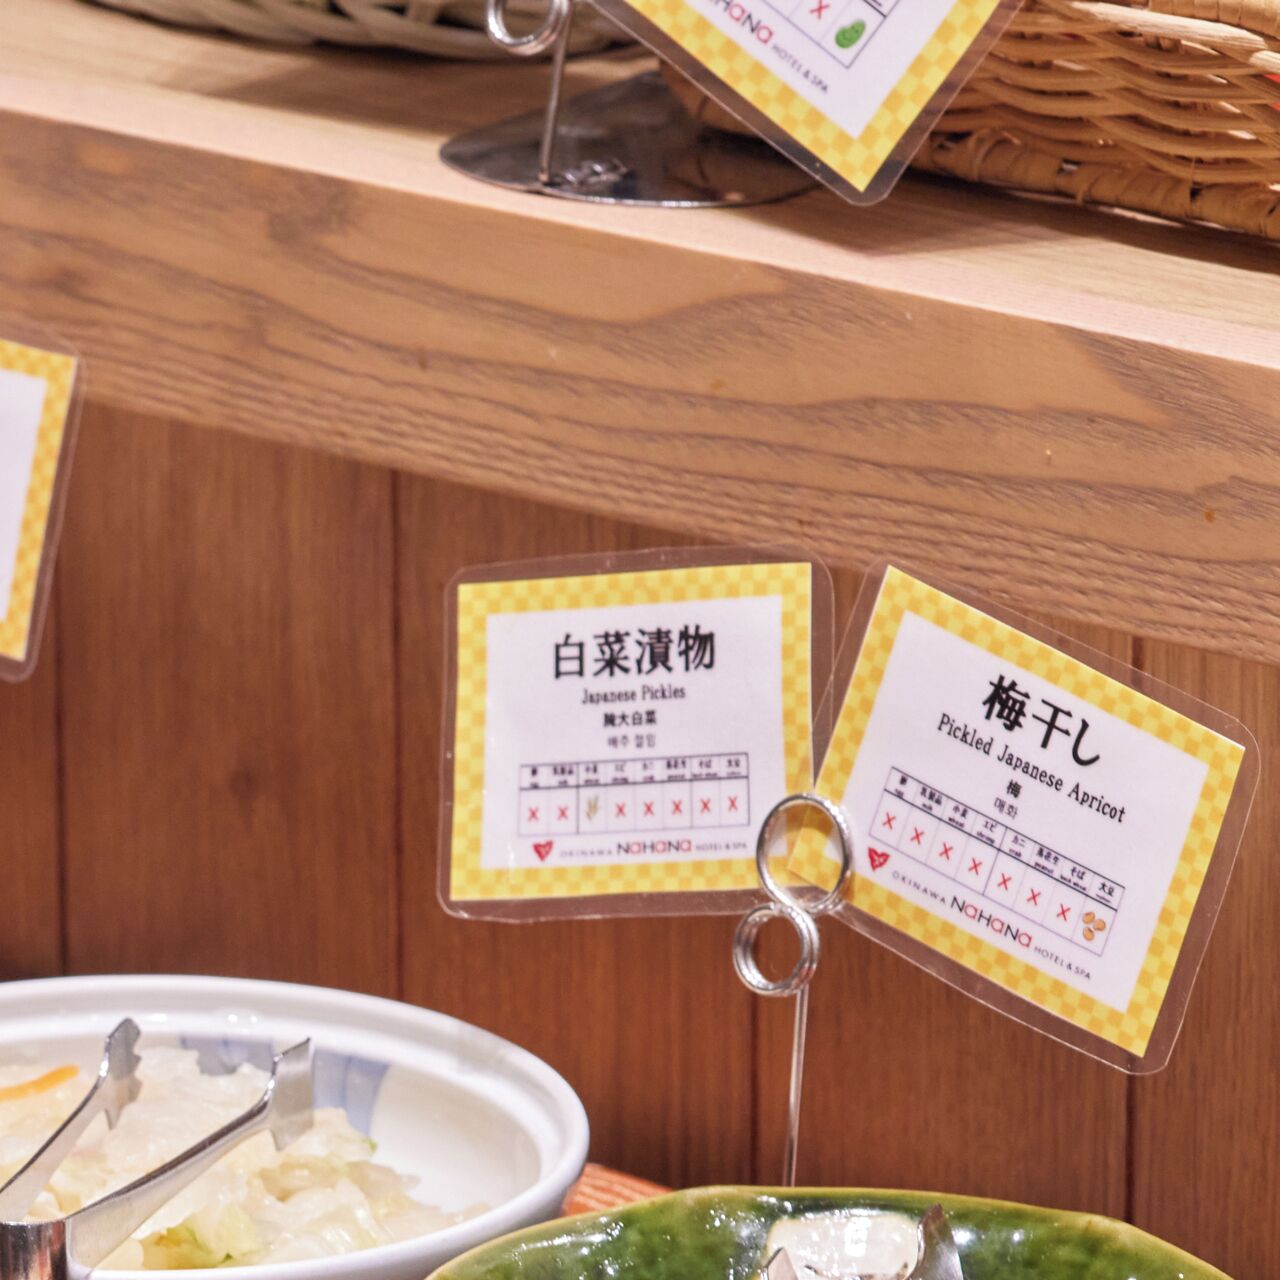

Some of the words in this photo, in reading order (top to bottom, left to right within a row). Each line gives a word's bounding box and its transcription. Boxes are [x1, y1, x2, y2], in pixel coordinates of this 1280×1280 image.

[810, 74, 829, 94] SPA
[554, 623, 716, 680] 白菜漬物
[581, 688, 637, 706] Japanese
[641, 683, 686, 701] Pickles
[981, 674, 1101, 767] 梅干し
[937, 712, 994, 756] Pickled
[996, 744, 1064, 792] Japanese
[1067, 782, 1126, 824] Apricot
[993, 796, 1018, 820] 매화
[1006, 779, 1023, 799] 梅
[892, 870, 946, 905] OKINAWA
[1033, 945, 1064, 967] HOTEL
[1074, 966, 1091, 980] SPA
